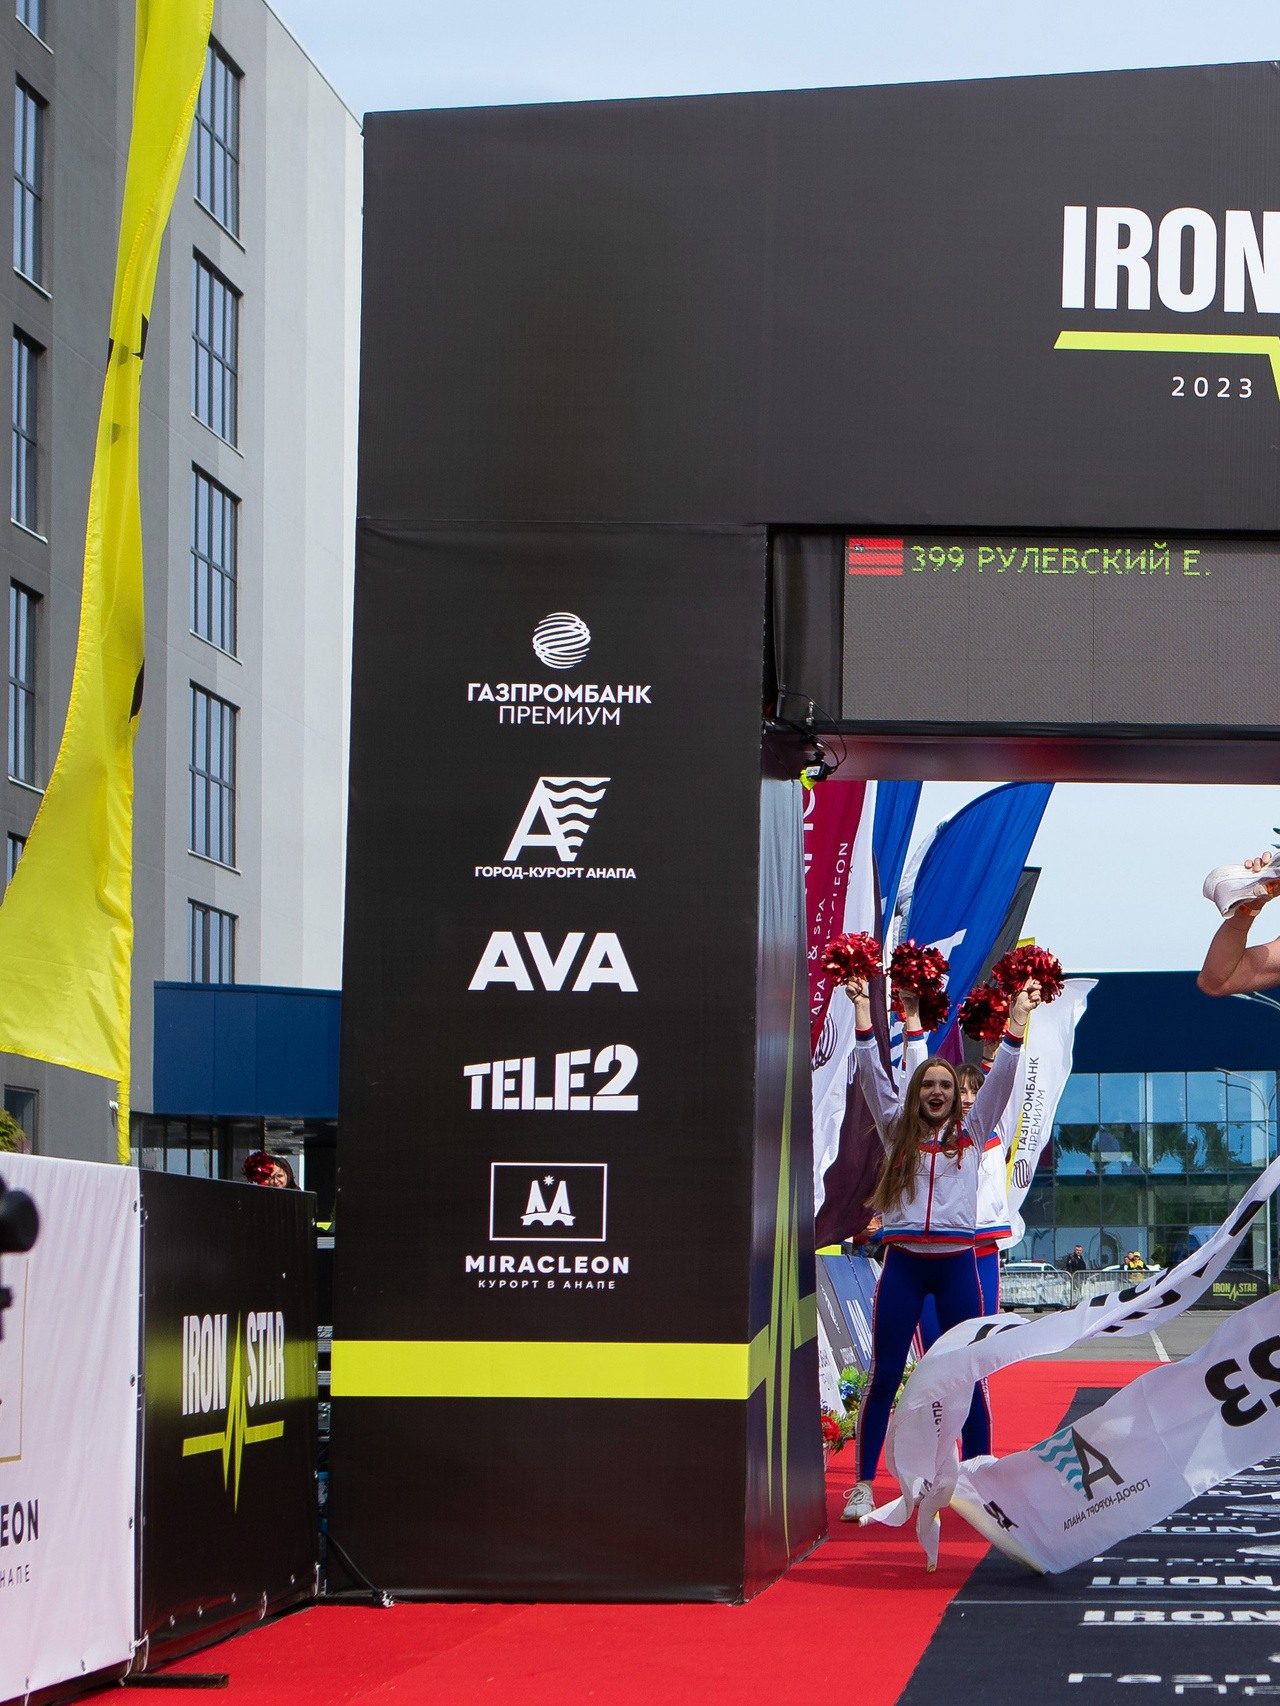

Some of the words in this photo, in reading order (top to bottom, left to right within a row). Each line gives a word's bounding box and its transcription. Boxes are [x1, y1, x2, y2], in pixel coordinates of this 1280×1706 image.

[1171, 376, 1252, 399] 2023
[911, 546, 965, 572] 399
[978, 542, 1170, 575] РУЛЕВСКИЙ
[1183, 550, 1211, 576] Е.
[468, 683, 652, 703] ГАЗПРОМБАНК
[499, 706, 621, 725] ПРЕМИУМ
[475, 866, 584, 879] ГОРОД-КУРОРТ
[586, 867, 636, 879] АНАПА
[468, 931, 639, 992] AVA
[463, 1044, 639, 1111] TELE2
[1017, 1057, 1039, 1151] ГАЗПРОМБАНК
[1028, 1089, 1045, 1152] ПРЕМИУМ
[465, 1255, 629, 1274] MIRACLEON
[478, 1280, 538, 1289] КУРОРТ
[547, 1280, 554, 1288] В
[563, 1280, 615, 1289] АНАПЕ
[1213, 1283, 1230, 1292] IRON
[1239, 1283, 1258, 1292] STAR
[182, 1313, 228, 1416] IRON
[246, 1311, 286, 1408] STAR
[1091, 1576, 1273, 1586] IRON
